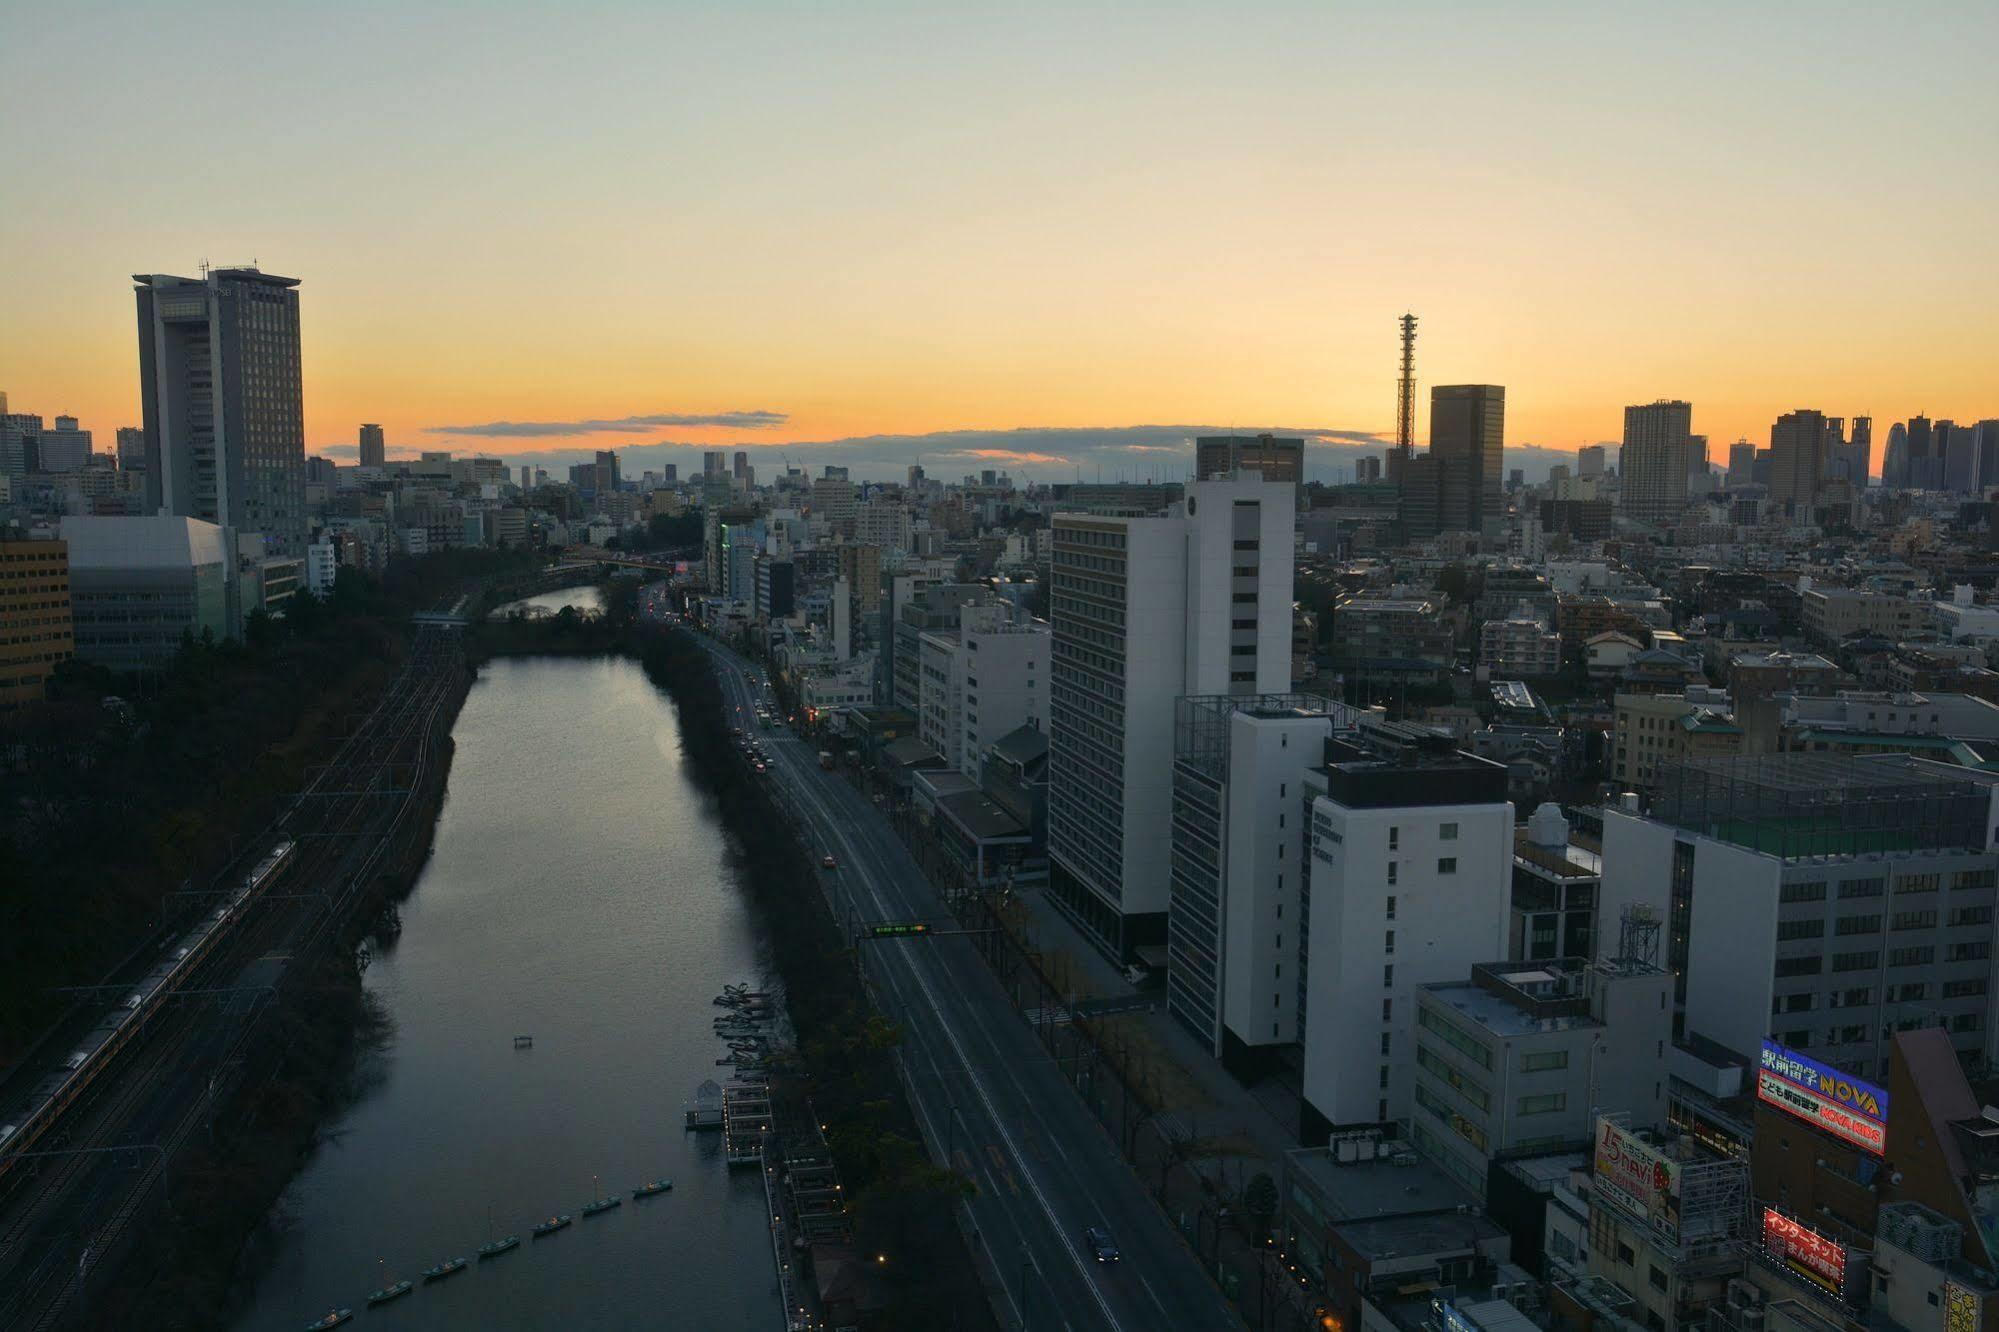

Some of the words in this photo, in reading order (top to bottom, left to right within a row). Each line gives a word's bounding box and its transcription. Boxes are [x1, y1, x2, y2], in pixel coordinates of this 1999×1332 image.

[1761, 1048, 1818, 1087] 駅前留学
[1819, 1074, 1881, 1116] NOVA
[1759, 1078, 1819, 1114] こども駅前留学
[1820, 1105, 1853, 1130] NOVA
[1853, 1119, 1881, 1144] KIDS
[1768, 1217, 1842, 1263] インターネット
[1787, 1241, 1841, 1281] まんが喫茶
